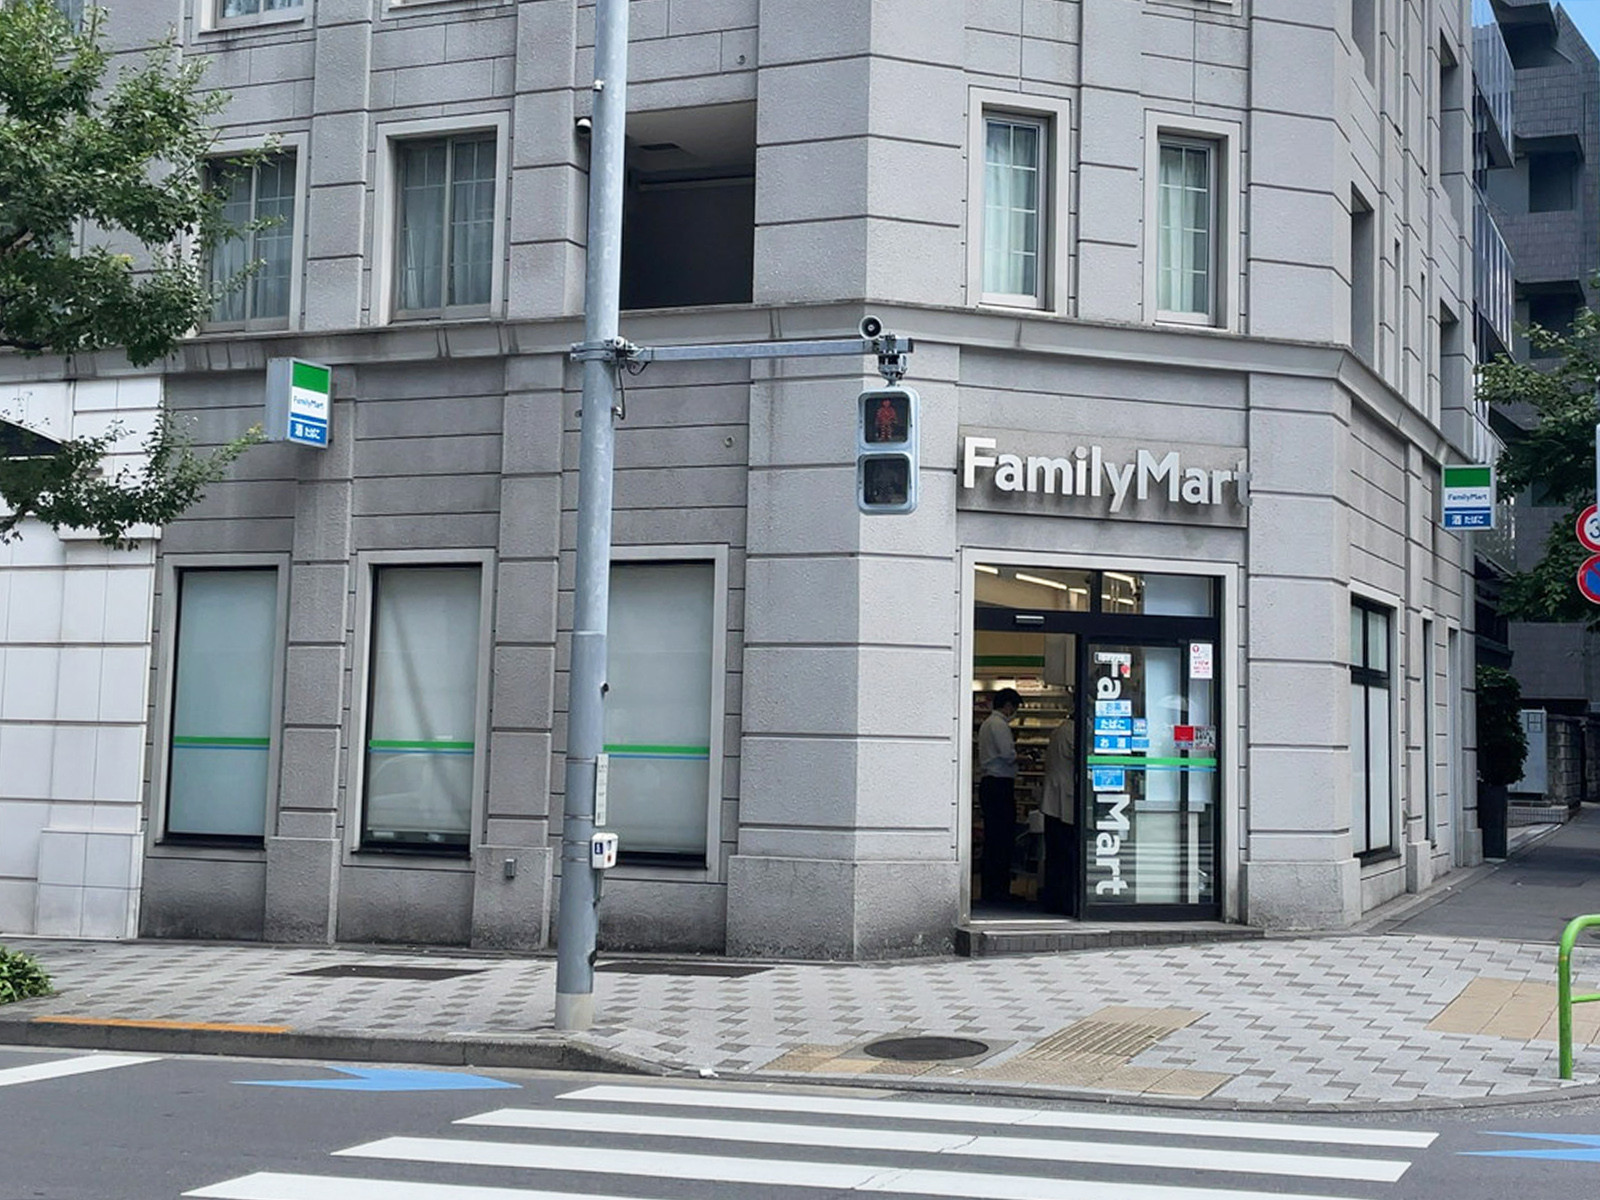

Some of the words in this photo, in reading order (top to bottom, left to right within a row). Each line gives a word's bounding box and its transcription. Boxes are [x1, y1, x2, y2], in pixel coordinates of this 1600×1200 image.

[294, 395, 324, 409] FamilyMart
[963, 436, 1253, 513] FamilyMart
[1448, 494, 1488, 502] FamilyMart
[1464, 516, 1484, 525] たばこ
[1100, 719, 1126, 730] たばこ
